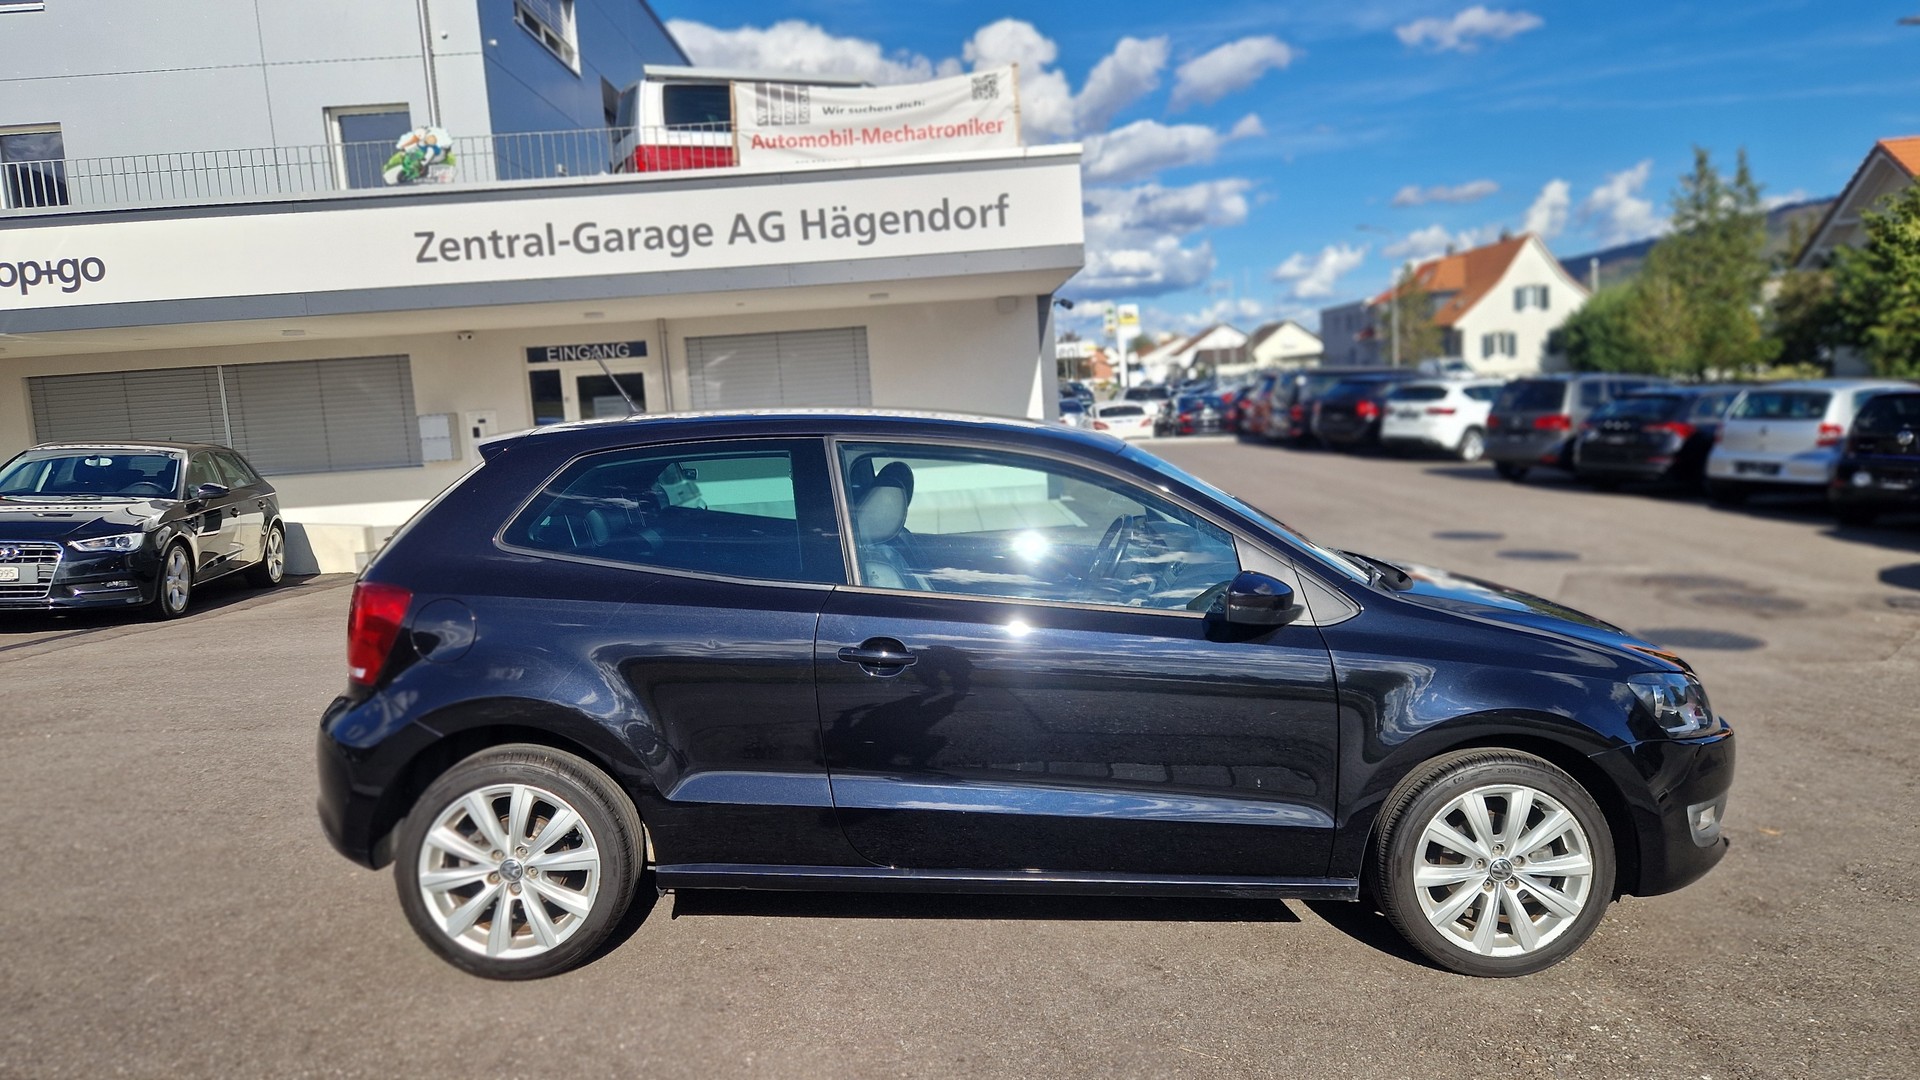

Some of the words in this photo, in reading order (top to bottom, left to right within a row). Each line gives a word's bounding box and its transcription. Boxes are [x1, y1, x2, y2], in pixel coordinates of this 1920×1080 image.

[822, 106, 844, 115] Wir
[848, 104, 892, 113] suchen
[751, 117, 1005, 150] Automobil-Mechatroniker
[414, 221, 714, 263] Zentral-Garage
[728, 210, 786, 245] AG
[800, 193, 1010, 246] Hägendorf
[546, 342, 630, 362] EINGANG
